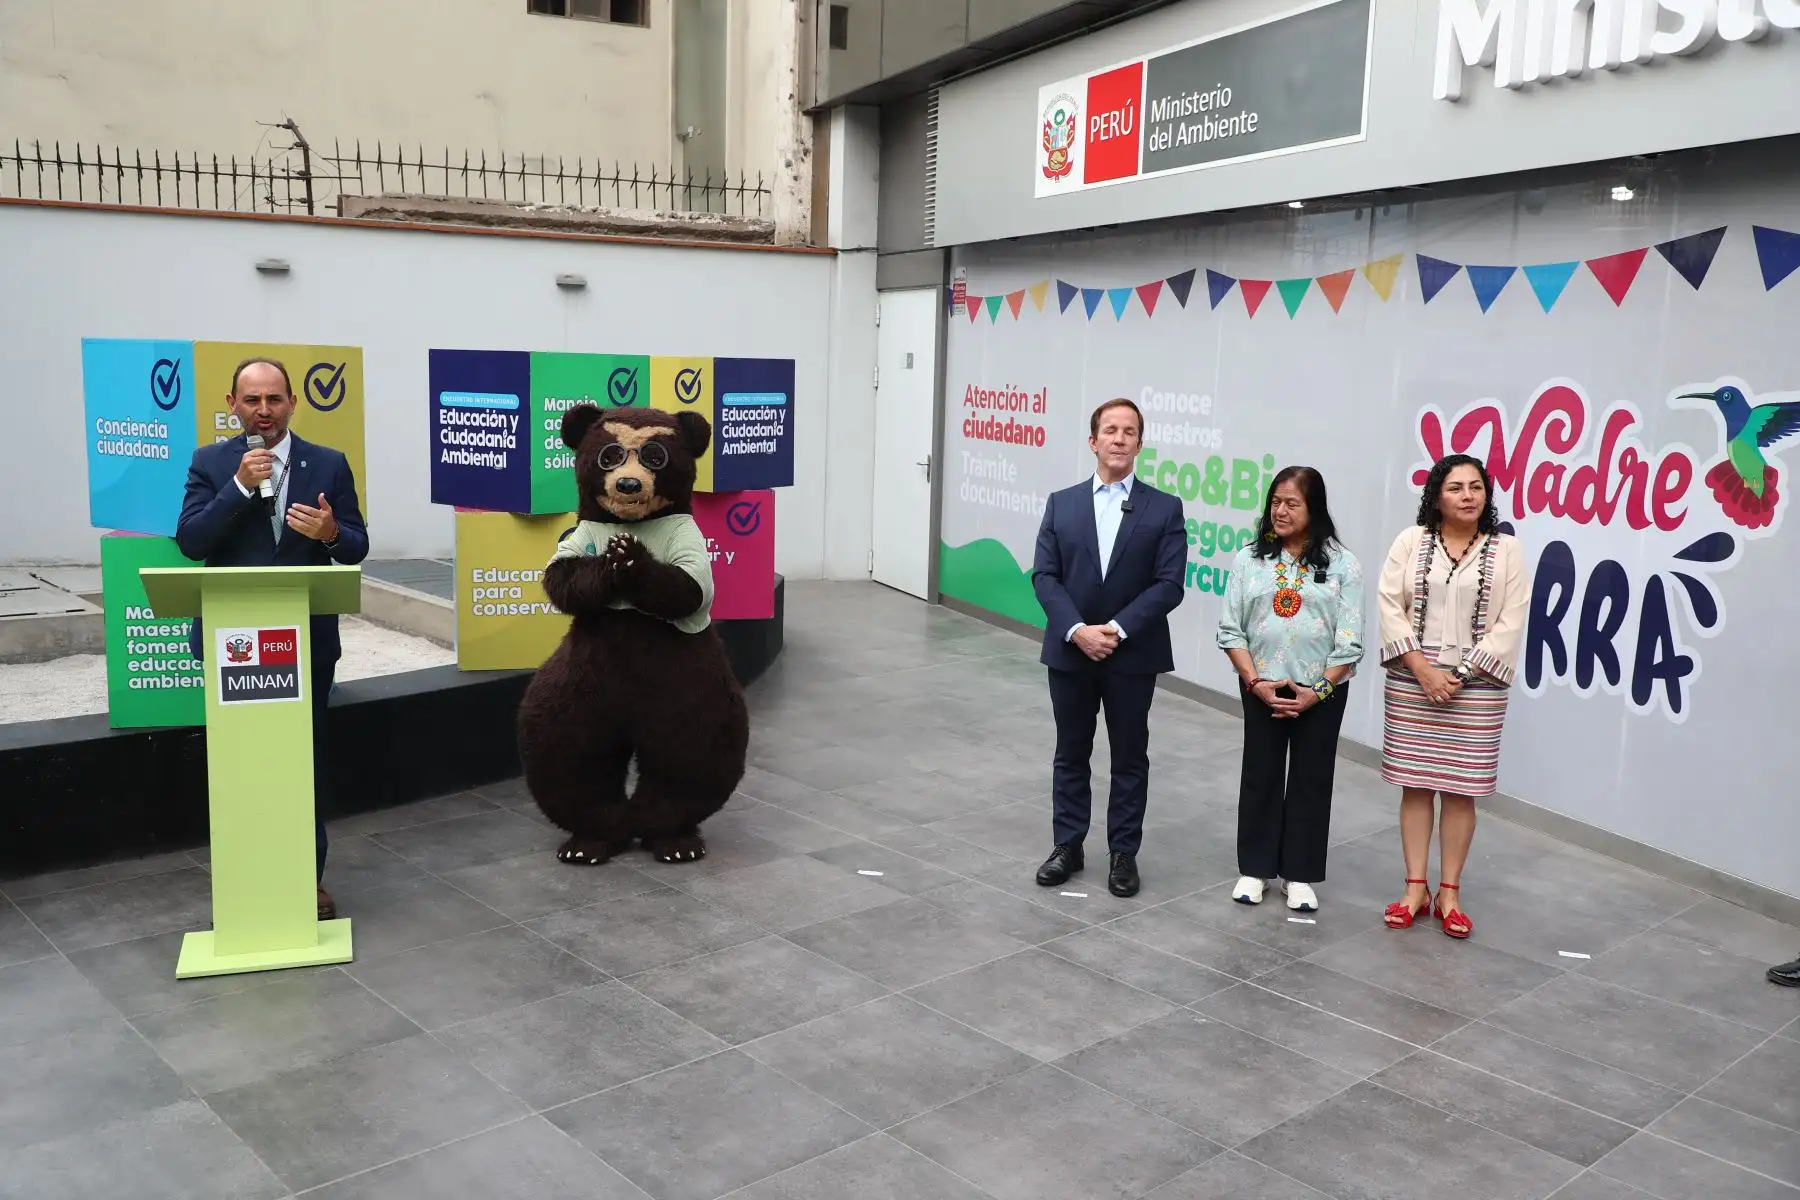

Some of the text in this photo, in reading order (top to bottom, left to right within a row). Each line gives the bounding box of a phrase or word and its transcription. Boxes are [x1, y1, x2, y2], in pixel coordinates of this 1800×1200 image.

[1433, 0, 1800, 101] Minis
[1151, 83, 1232, 123] Ministerio
[1090, 98, 1134, 144] PERÚ
[1149, 110, 1258, 152] del Ambiente
[964, 383, 1047, 414] Atención al
[1141, 386, 1212, 415] Conoce
[440, 408, 519, 433] Educación y
[722, 405, 786, 424] Educación y
[96, 416, 168, 439] Conciencia
[962, 411, 1046, 447] ciudadano
[97, 435, 169, 460] ciudadana
[544, 435, 563, 449] de
[722, 438, 777, 455] Ambiental
[441, 447, 507, 469] Ambiental
[544, 452, 576, 469] sóli
[1451, 386, 1693, 531] Madre
[1136, 448, 1275, 515] Eco&Bi
[960, 476, 1048, 517] documenta
[1184, 518, 1261, 558] egoc
[725, 551, 735, 565] y
[472, 568, 545, 582] Educar
[472, 586, 522, 601] para
[473, 601, 562, 616] conserv
[126, 622, 192, 637] maest
[1525, 540, 1694, 715] RRA
[127, 639, 192, 655] fomen
[263, 639, 293, 653] PERÚ
[128, 656, 204, 672] educac
[128, 672, 205, 689] ambien
[228, 673, 294, 691] MINAM
